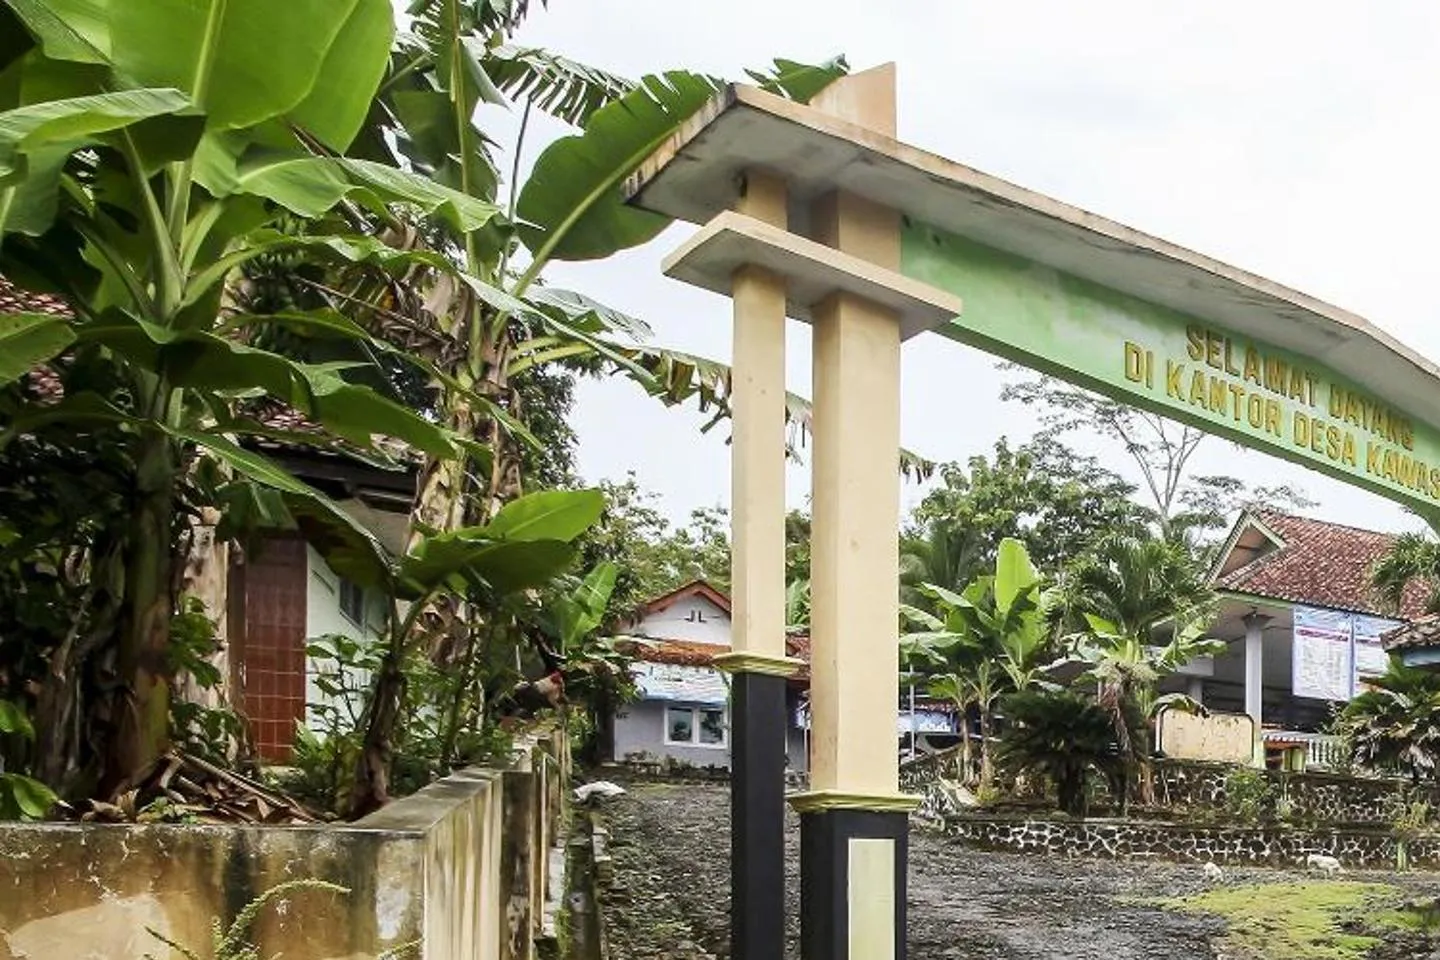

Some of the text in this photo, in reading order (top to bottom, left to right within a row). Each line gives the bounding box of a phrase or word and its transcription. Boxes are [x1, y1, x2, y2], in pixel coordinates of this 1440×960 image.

[1124, 341, 1154, 390] DI
[1166, 359, 1282, 438] KANTOR
[1292, 411, 1357, 467] DESA
[1186, 324, 1320, 407] SELAMAT
